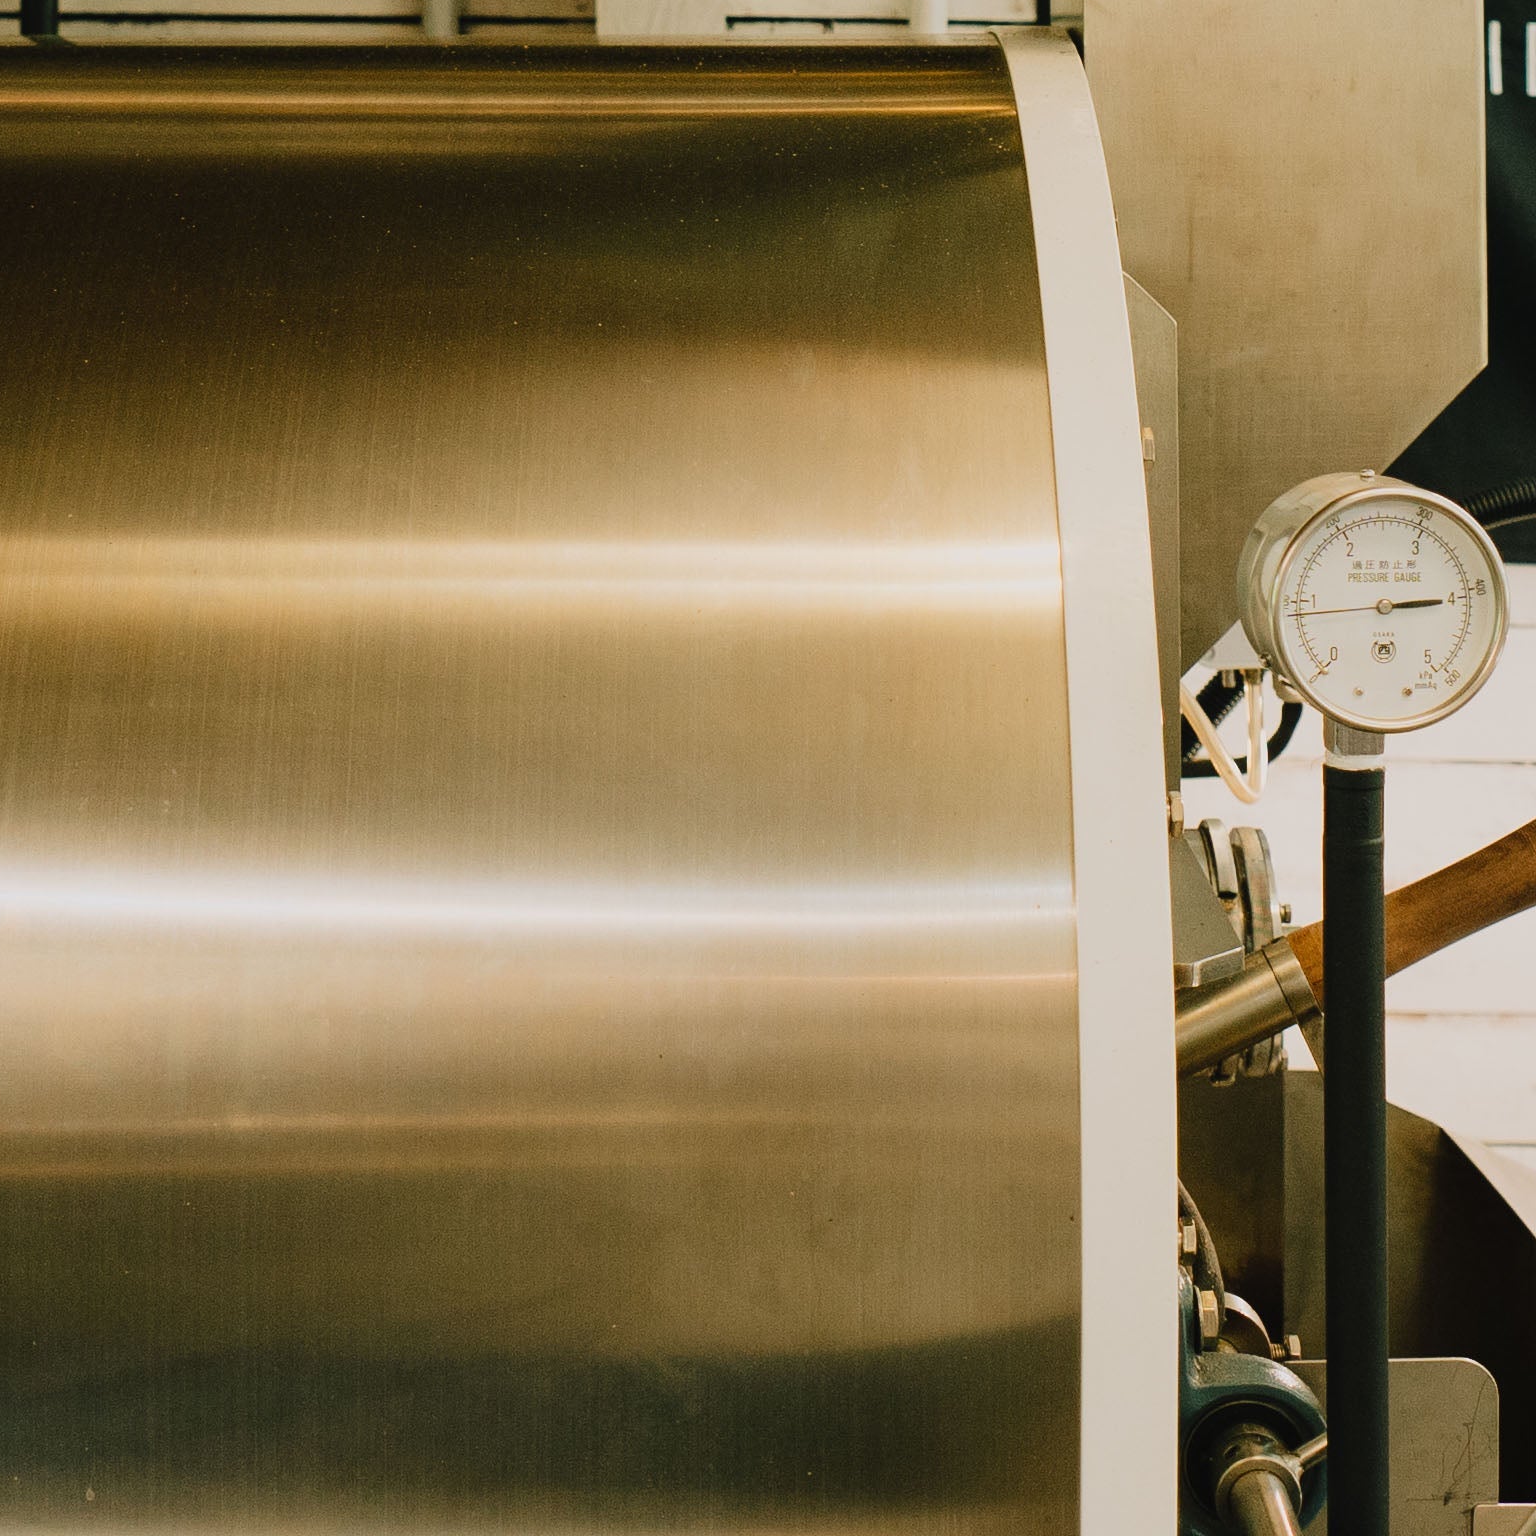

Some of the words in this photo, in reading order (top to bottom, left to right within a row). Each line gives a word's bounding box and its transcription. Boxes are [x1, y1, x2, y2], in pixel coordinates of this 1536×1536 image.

[1416, 506, 1433, 521] 300
[1346, 542, 1354, 557] 2
[1412, 540, 1419, 555] 3
[1347, 572, 1389, 583] PRESSURE
[1393, 571, 1422, 583] GAUGE
[1476, 578, 1486, 596] 400
[1312, 594, 1316, 609] 1
[1447, 592, 1455, 606] 4
[1330, 646, 1338, 661] 0
[1424, 649, 1432, 664] 5
